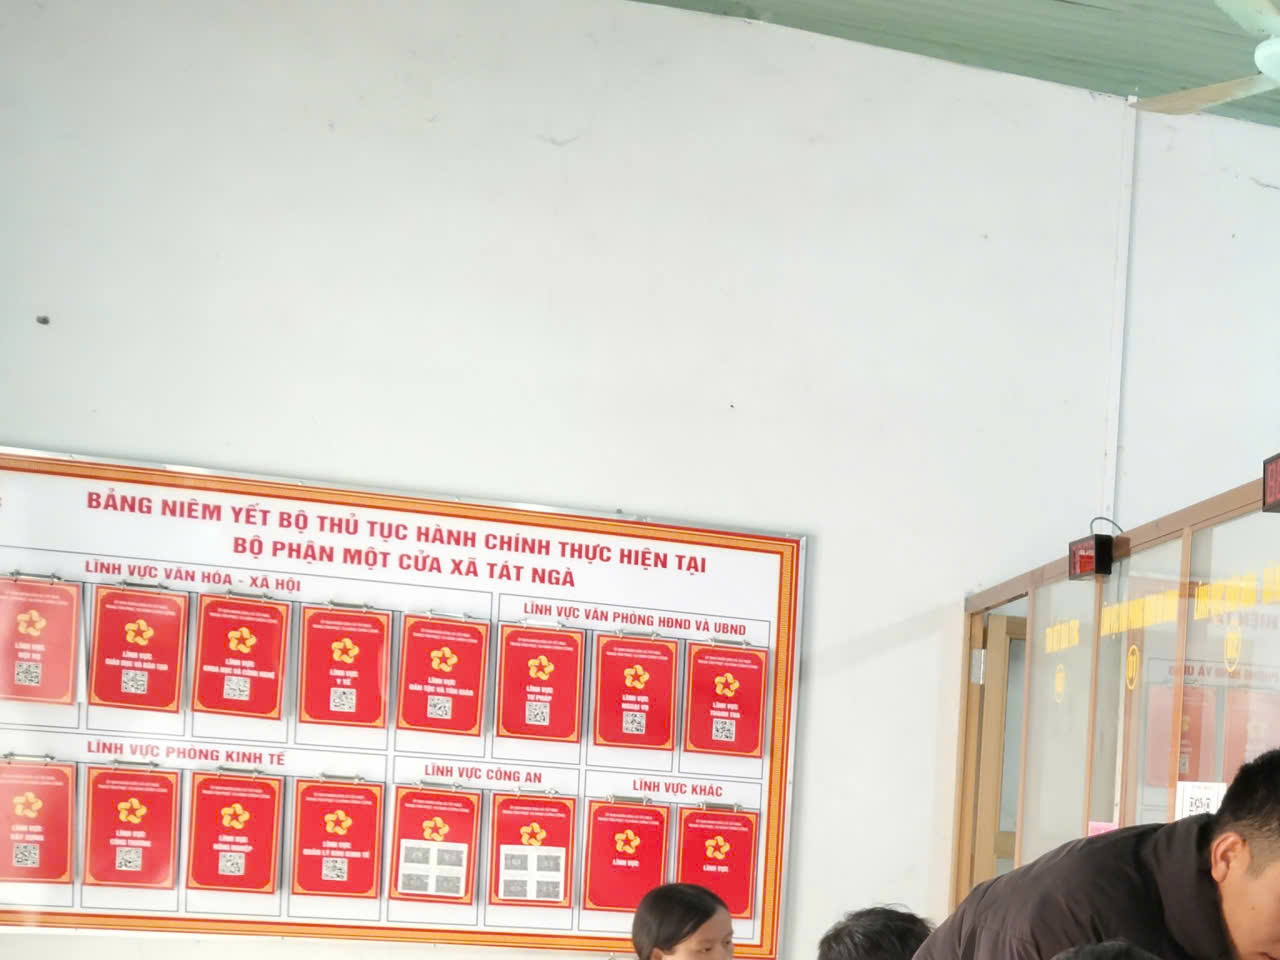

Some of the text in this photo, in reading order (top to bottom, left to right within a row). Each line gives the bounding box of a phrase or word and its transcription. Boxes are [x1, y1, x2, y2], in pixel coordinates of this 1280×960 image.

[87, 487, 706, 576] BẢNG NIÊM YẾT BỘ THỦ TỤC HÀNH CHÍNH THỰC HIỆN TẠI
[85, 558, 121, 575] LĨNH
[127, 564, 158, 581] VỰC
[164, 566, 195, 582] VĂN
[250, 574, 270, 590] XÃ
[275, 576, 301, 593] HỘI
[233, 535, 575, 587] BỘ PHẬN MỘT CỬA XÃ TÁT NGÀ
[523, 600, 551, 616] LĨNH
[556, 605, 580, 621] VỰC
[658, 616, 691, 630] HĐND
[695, 618, 710, 632] VÀ
[714, 622, 746, 636] UBND
[225, 751, 263, 764] KINH
[268, 750, 286, 766] TẾ
[457, 765, 482, 781] VỰC
[486, 767, 520, 782] CÔNG
[524, 772, 543, 784] AN
[664, 780, 687, 797] VỰC
[691, 782, 723, 797] KHÁC
